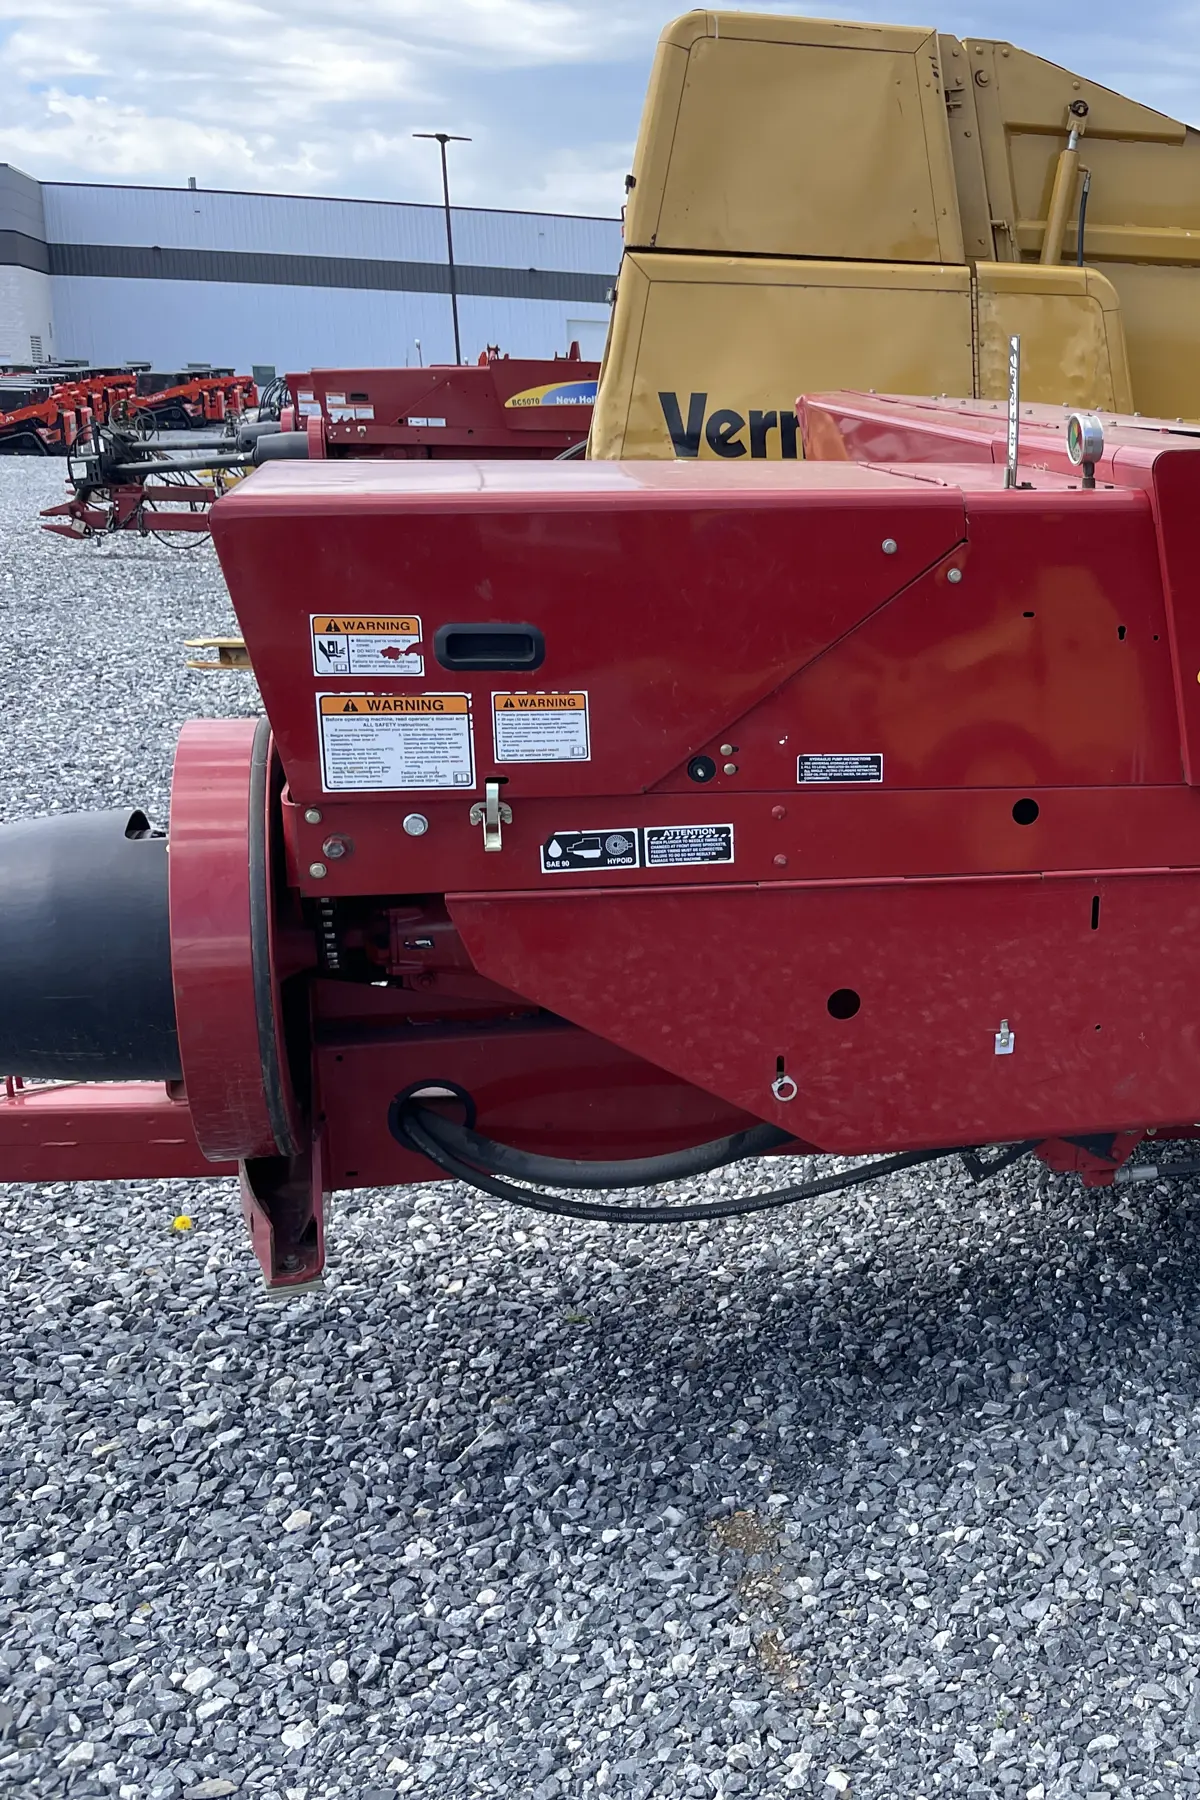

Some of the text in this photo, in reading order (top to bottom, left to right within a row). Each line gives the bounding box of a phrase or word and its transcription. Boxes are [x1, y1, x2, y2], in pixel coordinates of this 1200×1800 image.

[342, 621, 410, 630] WARNING
[367, 700, 444, 711] WARNING
[518, 698, 576, 707] WARNING
[664, 828, 716, 837] ATTENTION
